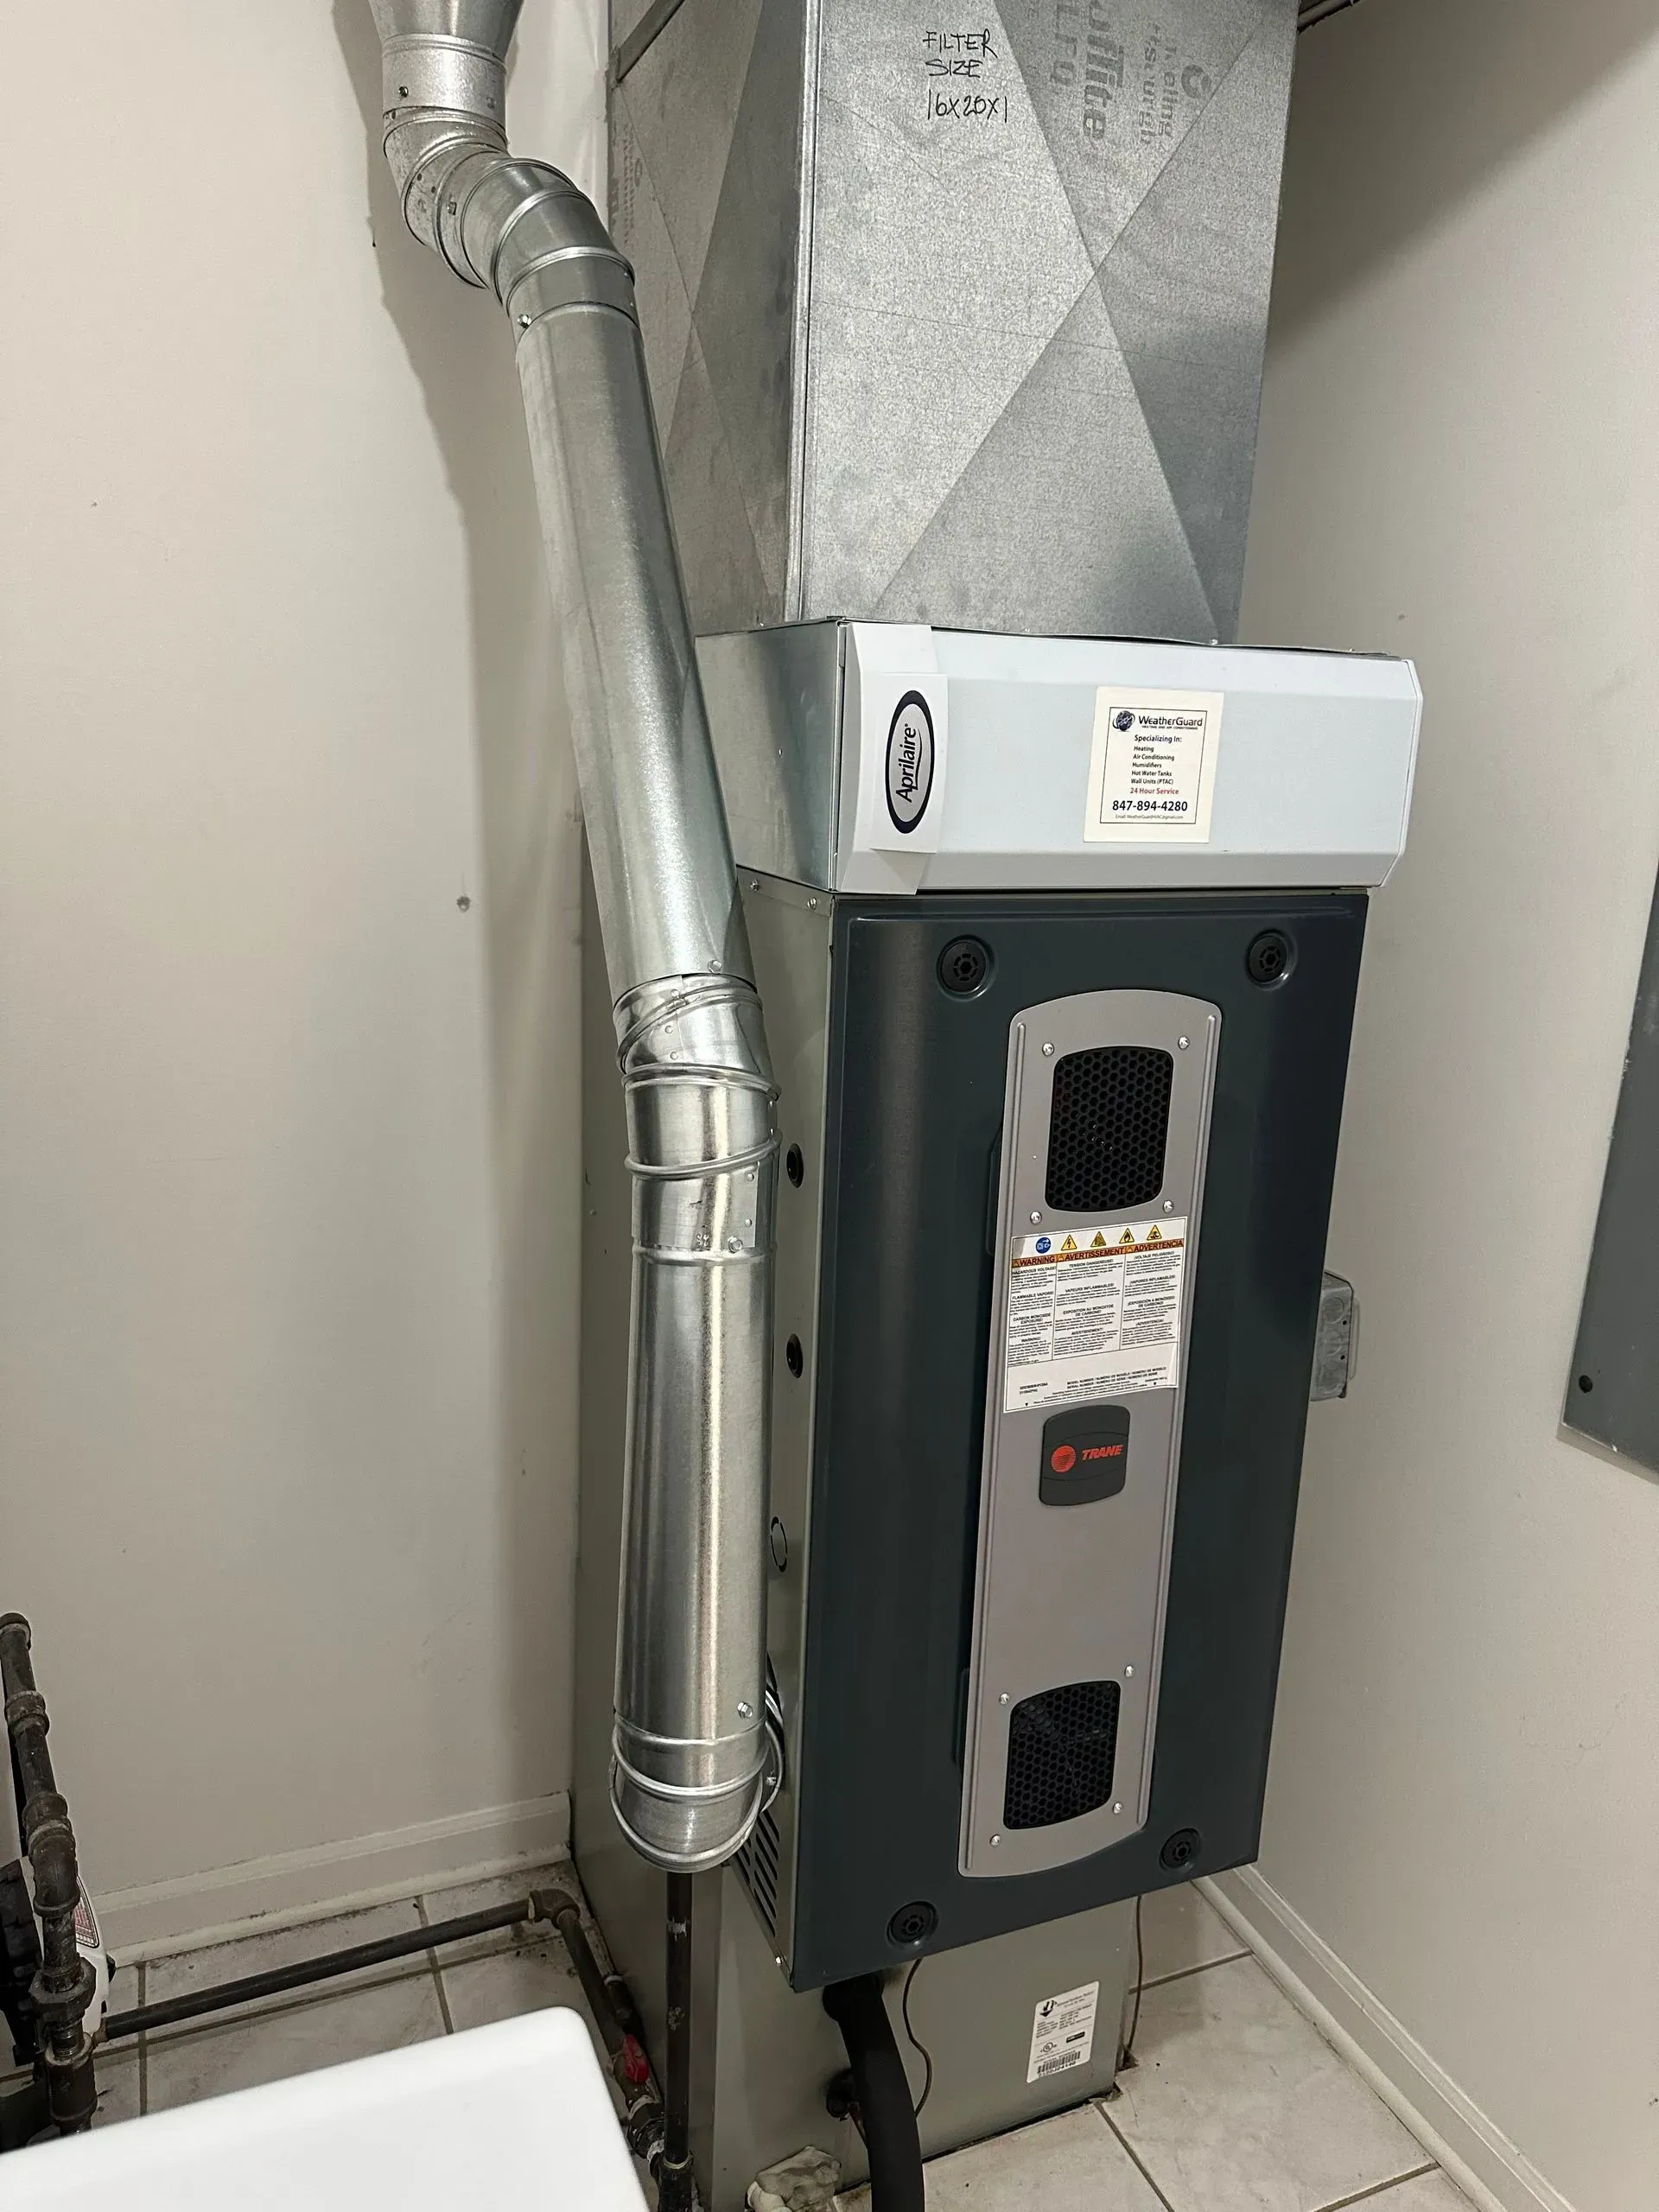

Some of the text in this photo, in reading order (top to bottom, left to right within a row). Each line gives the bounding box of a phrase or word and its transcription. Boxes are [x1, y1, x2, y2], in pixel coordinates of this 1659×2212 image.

[922, 29, 998, 58] FILTER
[925, 59, 983, 79] SIZE
[927, 89, 1007, 124] 16X20X1
[1138, 715, 1204, 727] WeatherGuard
[1135, 734, 1173, 743] Specializing
[895, 726, 918, 804] Aprilaire
[1112, 800, 1188, 812] 847-894-4280
[1134, 1241, 1182, 1252] ADVERTENCIA
[1020, 1256, 1055, 1266] WARNING
[1065, 1248, 1123, 1261] AVERTISSEMENT
[1082, 1444, 1123, 1461] TRANE
